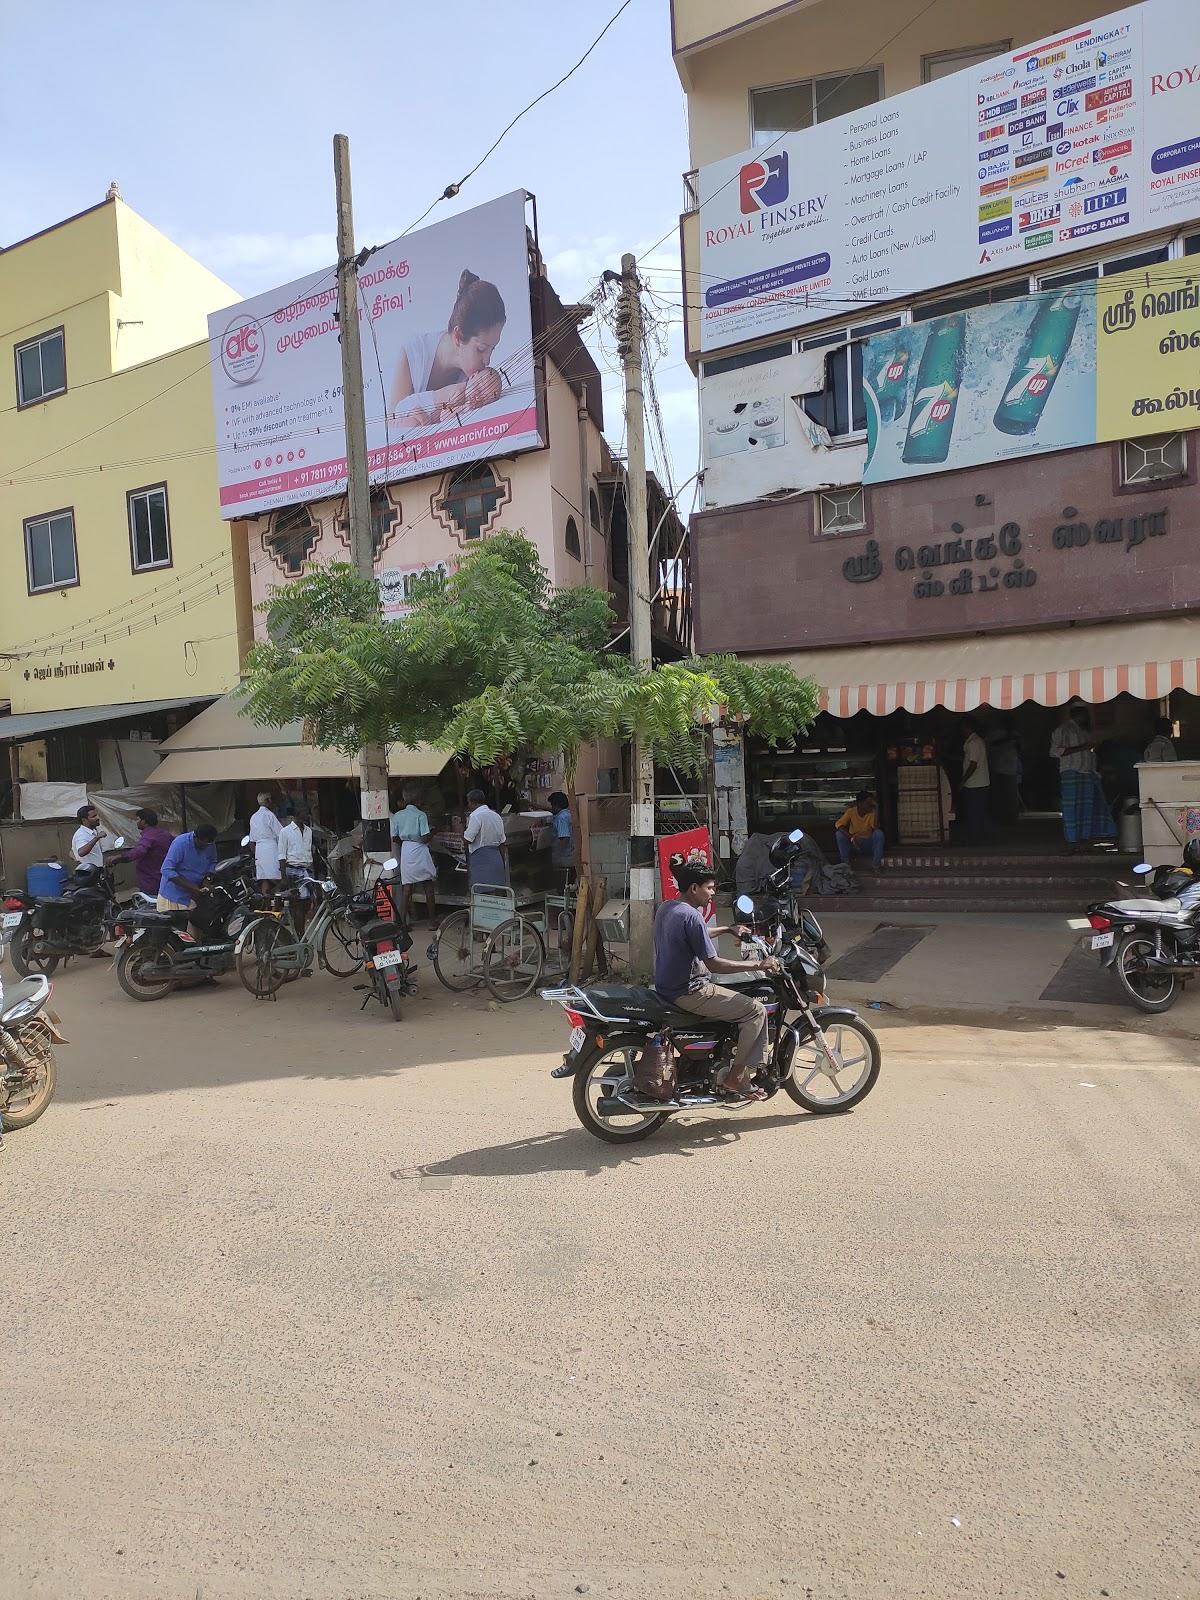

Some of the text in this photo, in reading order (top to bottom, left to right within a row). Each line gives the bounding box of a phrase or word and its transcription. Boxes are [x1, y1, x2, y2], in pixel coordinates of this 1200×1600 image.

[1065, 60, 1090, 75] Chola
[1108, 64, 1131, 76] CAPITAL
[1108, 72, 1125, 82] FLOAT
[1150, 65, 1200, 95] ROY
[1103, 90, 1130, 103] CAPITAL
[986, 106, 1000, 119] HDB
[1056, 98, 1079, 117] Clix
[1108, 101, 1136, 114] Fullerton
[1108, 112, 1123, 121] India
[849, 111, 899, 135] Personal Loans
[1009, 122, 1024, 133] DCB
[1025, 115, 1045, 127] BANK
[1063, 121, 1094, 136] FINANCE
[849, 128, 899, 151] Business Loans
[1073, 134, 1100, 148] kotak
[850, 147, 891, 167] Home Loans
[993, 146, 1008, 156] BANK
[1156, 145, 1187, 160] CORPORATE
[850, 168, 884, 184] Mortgage
[885, 161, 904, 174] Loans
[913, 150, 928, 164] LAP
[988, 160, 1009, 171] BAJAJ
[988, 166, 1009, 177] FINSERV
[1055, 152, 1089, 172] InCred
[1098, 172, 1129, 187] MAGMA
[1150, 175, 1175, 190] ROYAL
[850, 180, 909, 206] Machinery Loans
[1053, 180, 1095, 199] shubham
[850, 206, 884, 227] Overdraft
[891, 202, 910, 214] Cash
[911, 191, 934, 207] Credit
[935, 183, 961, 201] Facility
[1086, 191, 1125, 212] IIFL
[705, 194, 828, 248] ROYAL FINSERV
[1029, 203, 1060, 224] DHFL
[761, 226, 793, 244] Together
[794, 222, 806, 231] we
[1073, 215, 1126, 236] HDFC BANK
[851, 224, 894, 247] Credit Cards
[851, 254, 868, 265] Auto
[869, 247, 889, 260] Loans
[851, 267, 890, 285] Gold Loans
[786, 284, 808, 297] PRIVATE
[809, 277, 832, 291] LIMITED
[869, 285, 889, 297] Loans
[1102, 288, 1137, 335] ஸ்ரீ
[255, 405, 283, 421] advanced
[283, 396, 317, 413] technology
[263, 418, 288, 433] discount
[297, 407, 328, 423] treatment
[300, 471, 309, 484] 91
[310, 467, 326, 481] 7811
[327, 463, 343, 477] 999
[434, 422, 509, 451] www.arcivf.com
[842, 539, 883, 583] ஸ்ரீ
[912, 558, 1038, 599] ஸ்வீட்ஸ்
